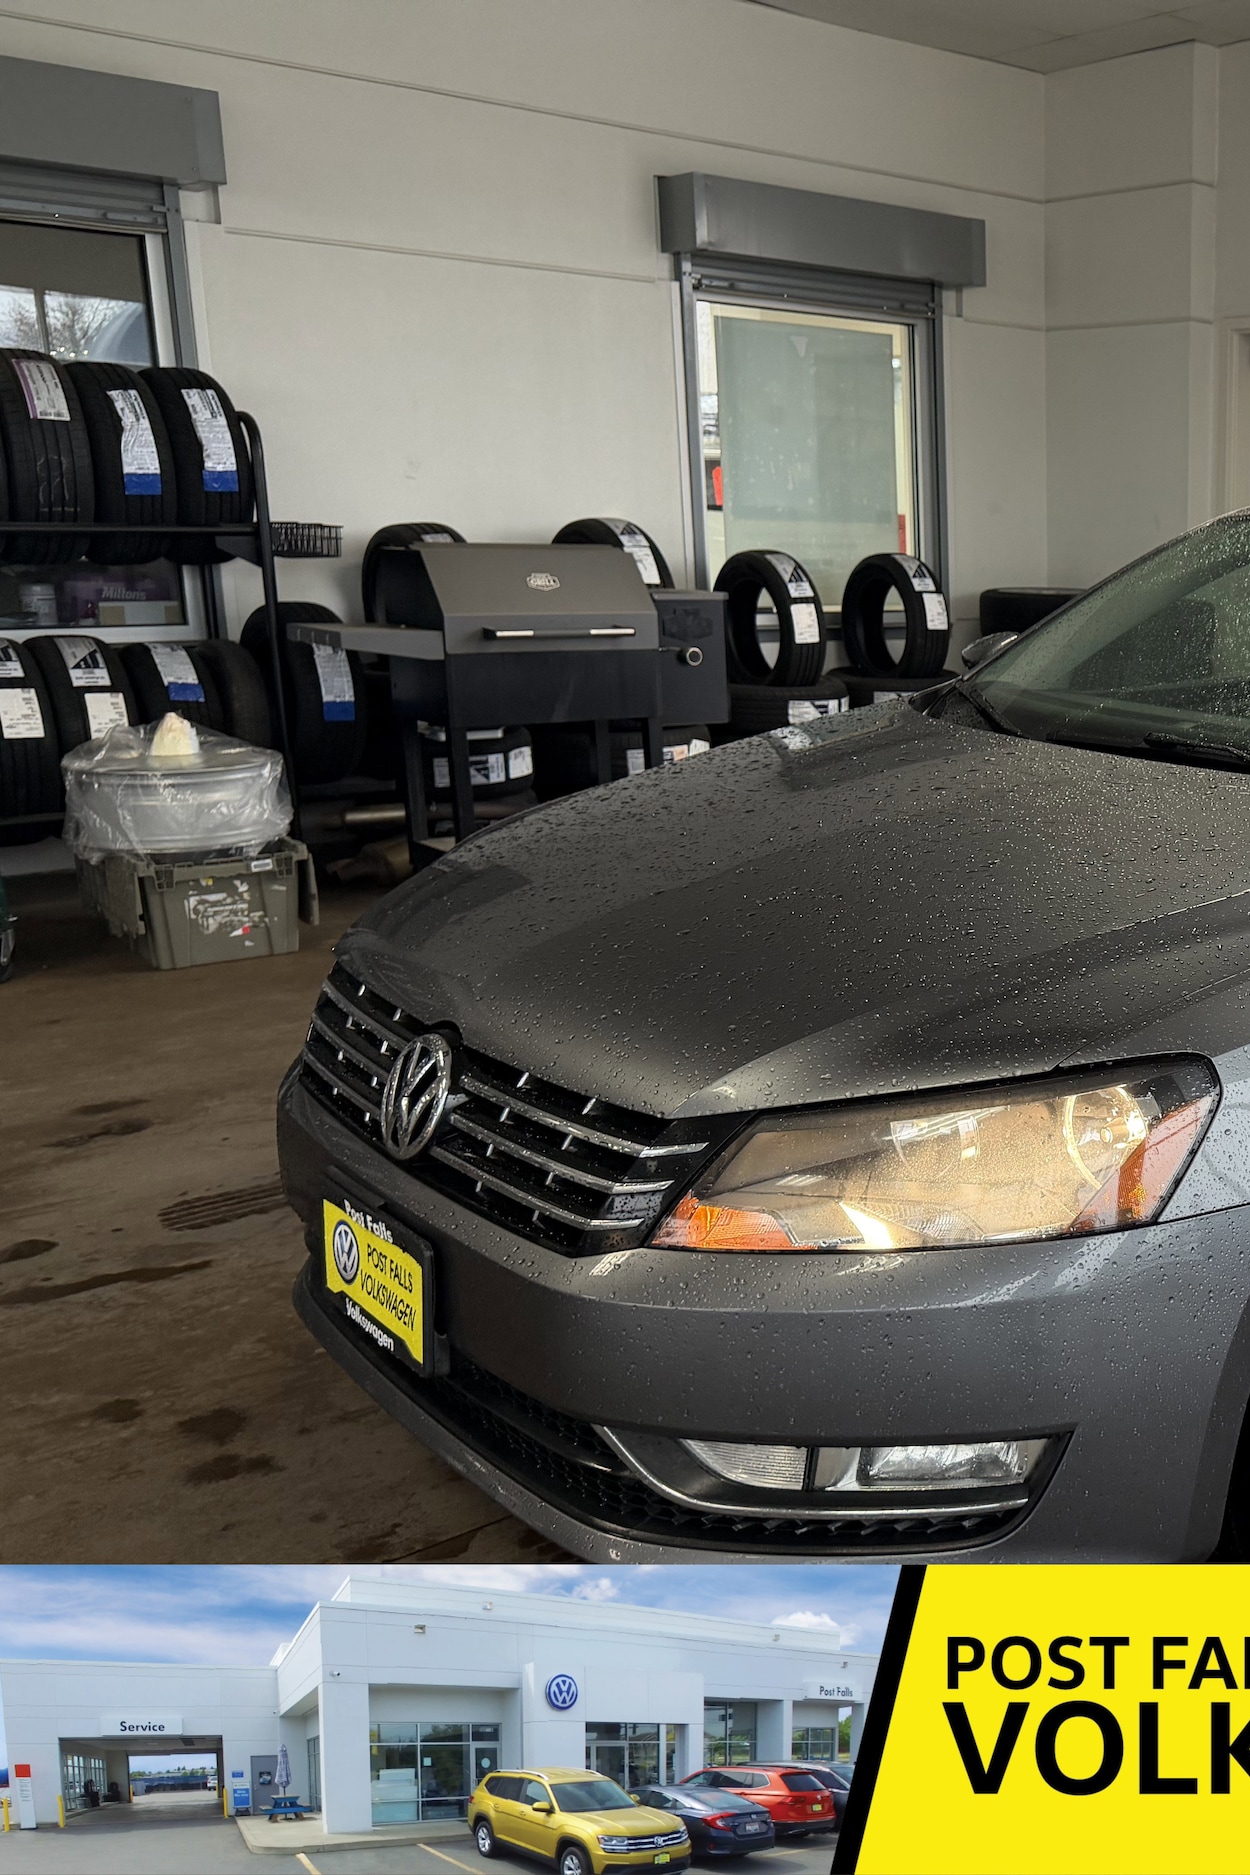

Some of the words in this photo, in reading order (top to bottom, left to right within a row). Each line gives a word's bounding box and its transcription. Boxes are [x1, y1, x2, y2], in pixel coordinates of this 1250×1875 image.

[344, 1199, 365, 1228] Post
[366, 1214, 393, 1244] Falls
[367, 1243, 388, 1276] POST
[389, 1259, 413, 1294] FALLS
[361, 1269, 417, 1332] VOLKSWAGEN
[345, 1298, 395, 1352] Volkswagen
[819, 1685, 835, 1697] Post
[836, 1686, 853, 1697] Falls
[119, 1720, 165, 1732] Service
